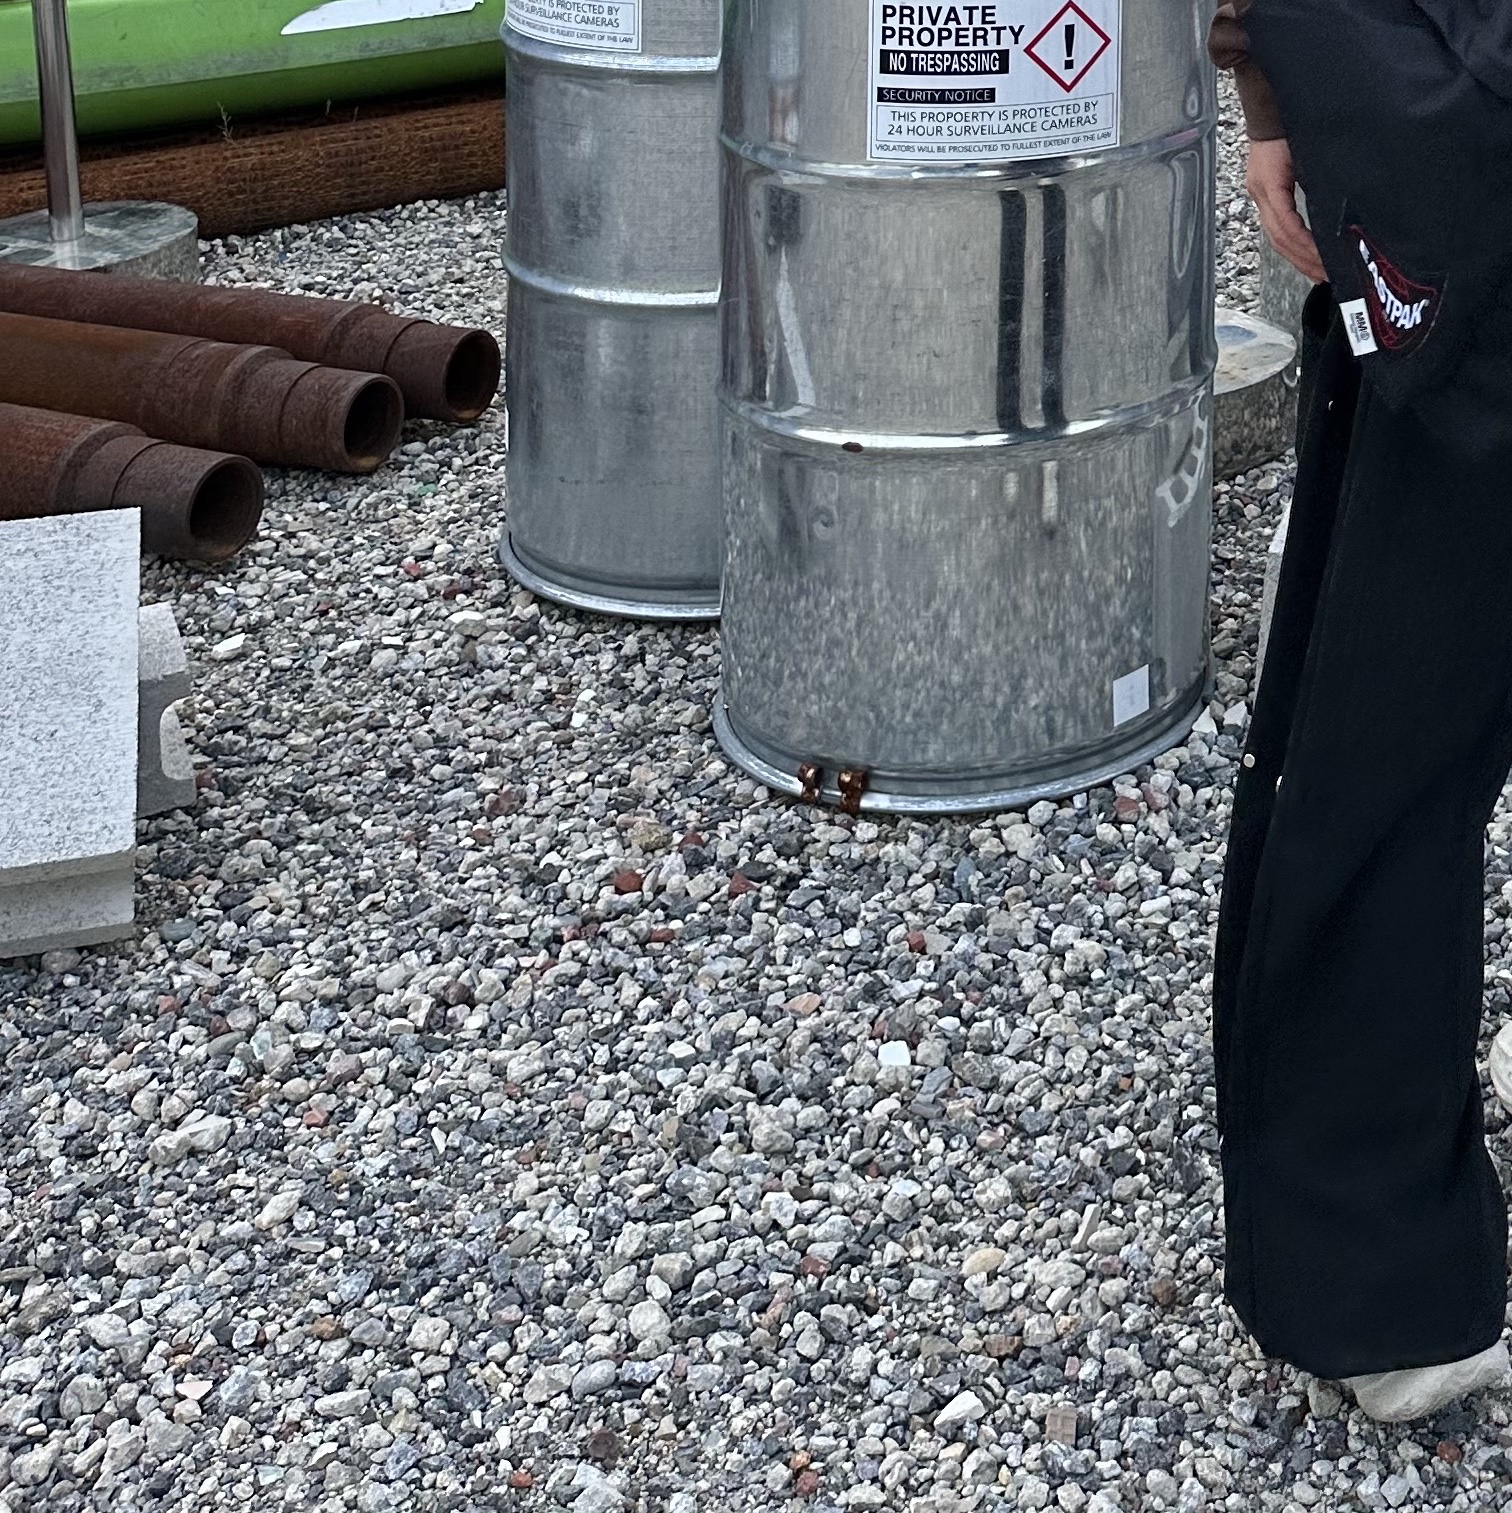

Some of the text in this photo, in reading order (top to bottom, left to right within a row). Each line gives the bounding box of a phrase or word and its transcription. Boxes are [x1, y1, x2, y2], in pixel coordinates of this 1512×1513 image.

[556, 0, 605, 15] PROTECTED
[607, 5, 620, 16] BY
[882, 4, 997, 26] PRIVATE
[574, 13, 620, 28] CAMERAS
[881, 24, 1026, 47] PROPERTY
[889, 52, 1000, 72] NO TRESPASSING
[883, 88, 992, 102] SECURITY NOTICE
[890, 99, 1099, 123] THIS PROPOERTY IS PROTECTED BY
[887, 113, 1098, 137] 24 HOUR SURVEILLANCE CAMERAS
[1000, 143, 1010, 151] TO
